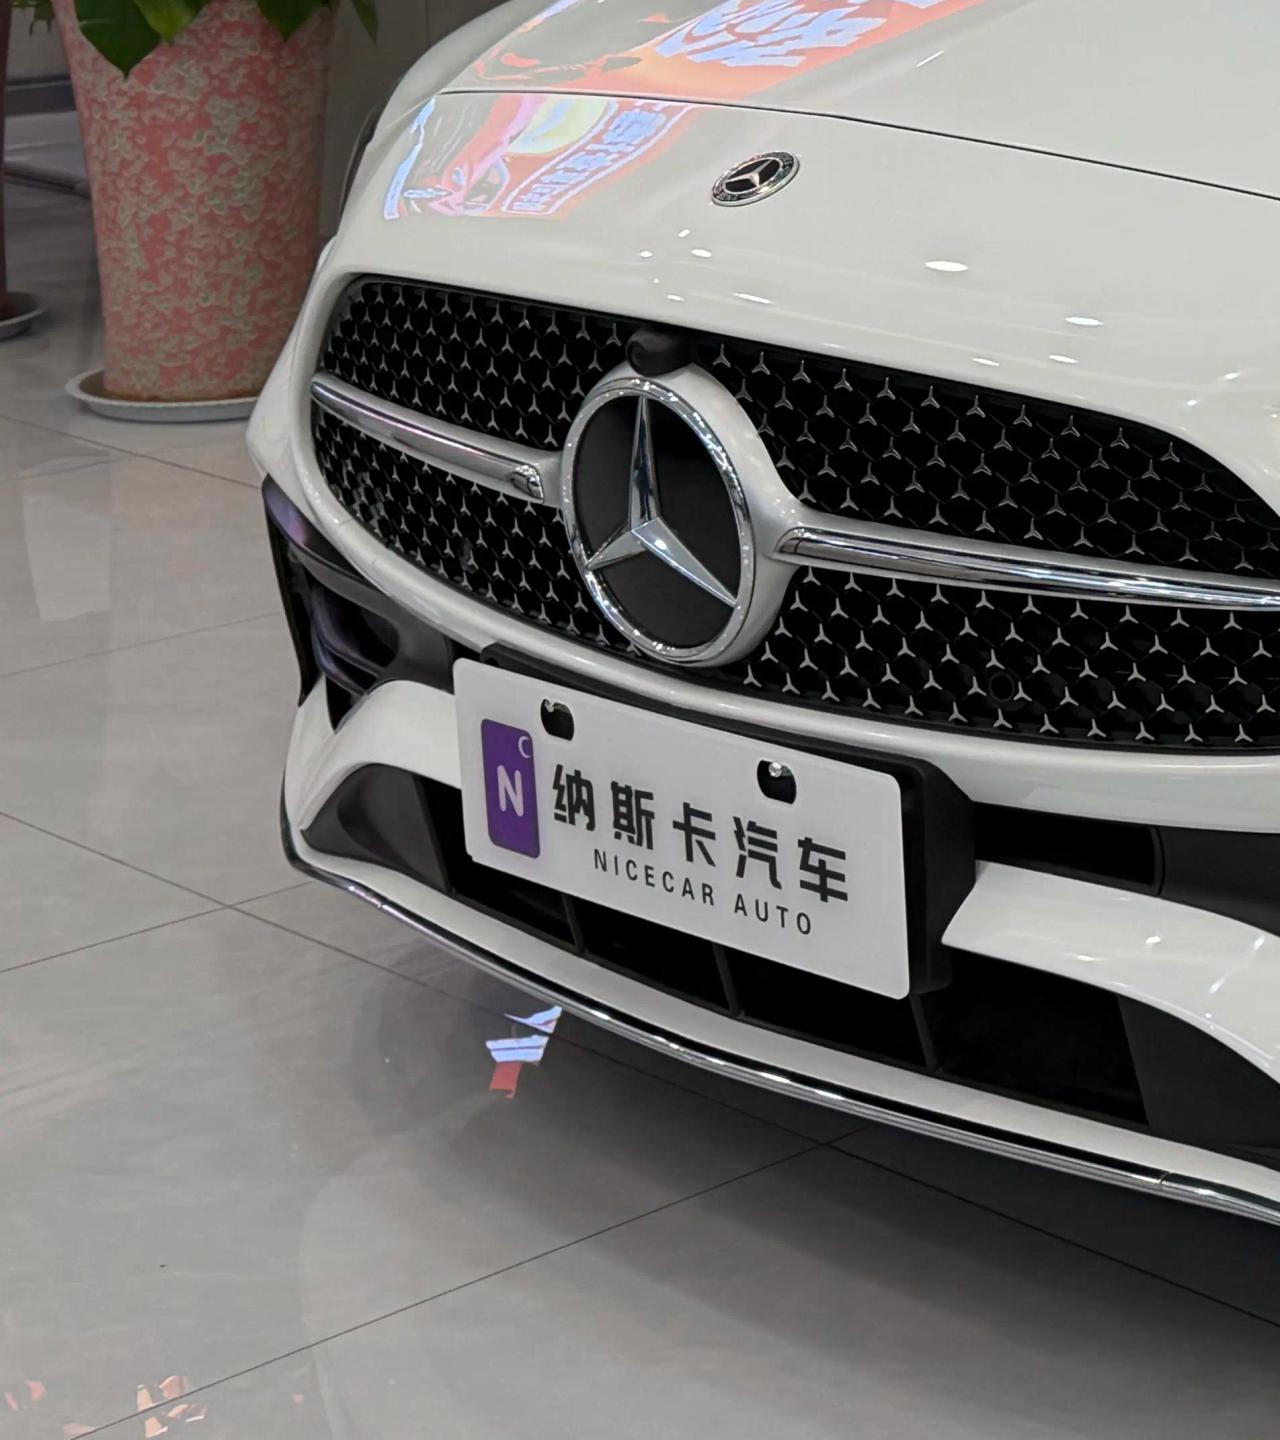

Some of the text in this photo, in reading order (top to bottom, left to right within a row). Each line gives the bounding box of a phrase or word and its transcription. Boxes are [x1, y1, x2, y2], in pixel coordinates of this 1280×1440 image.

[495, 764, 525, 818] N
[552, 763, 849, 904] 纳斯卡汽车
[594, 847, 813, 936] NICECAR AUTO
